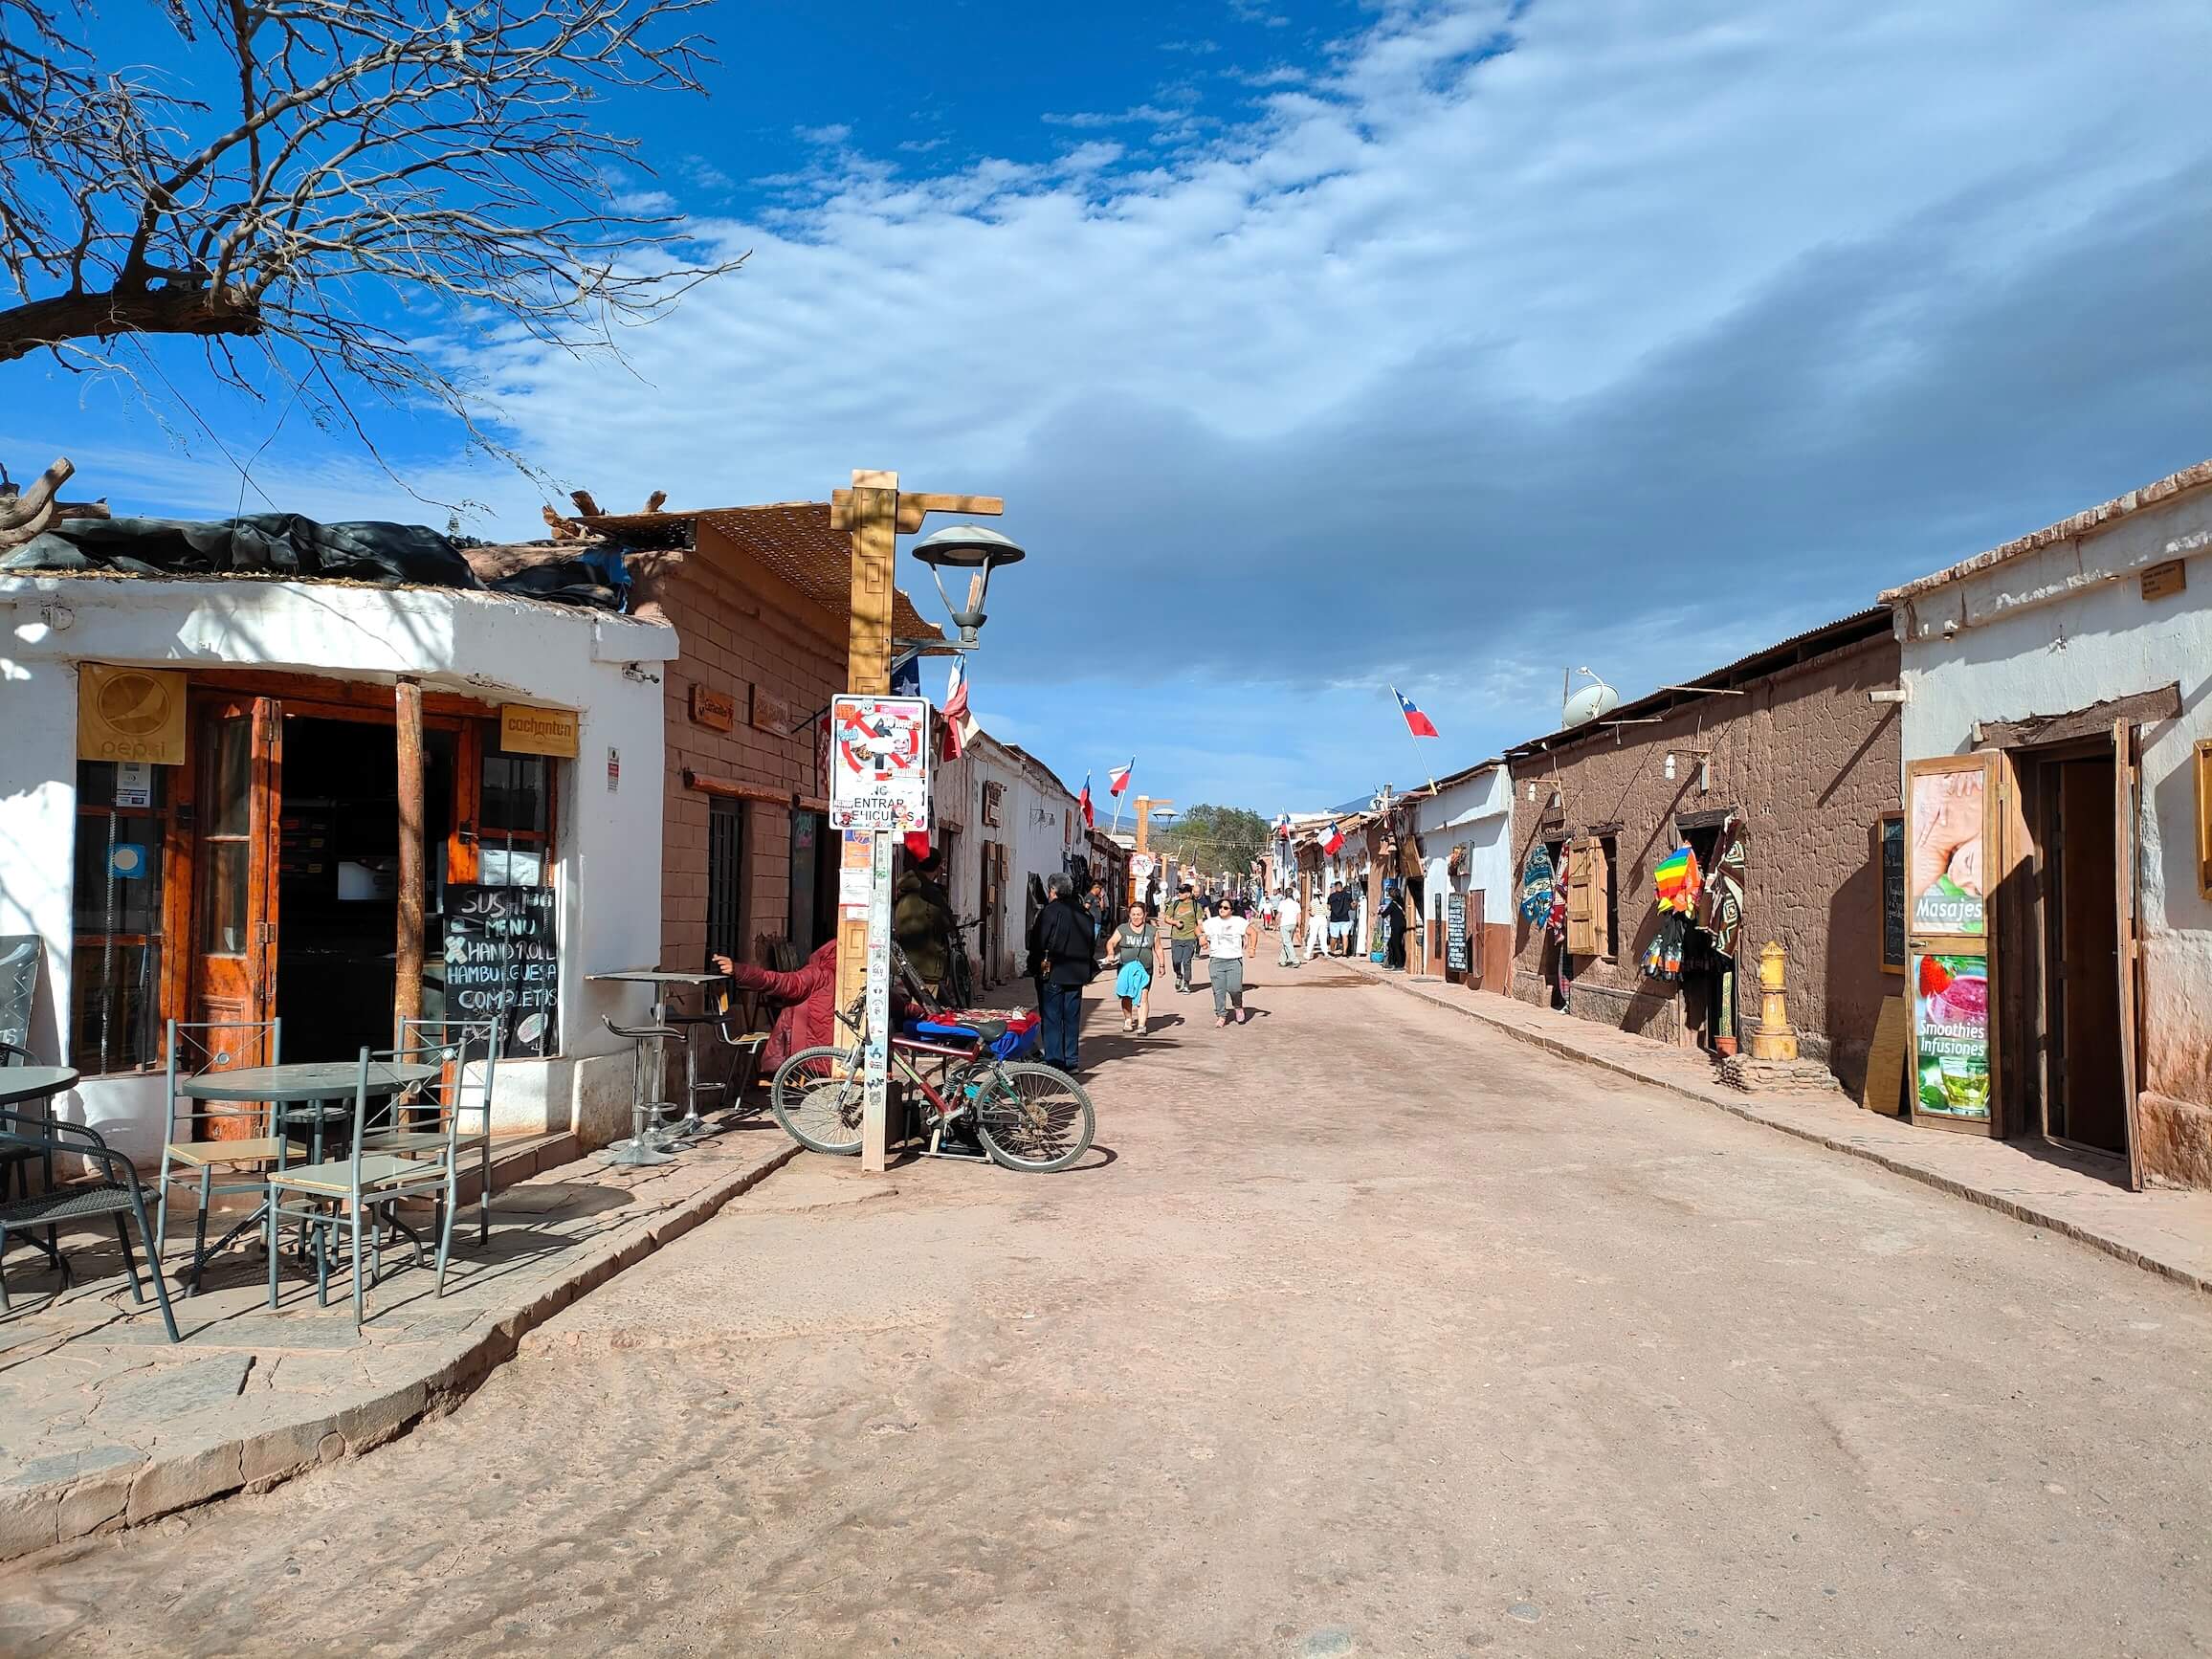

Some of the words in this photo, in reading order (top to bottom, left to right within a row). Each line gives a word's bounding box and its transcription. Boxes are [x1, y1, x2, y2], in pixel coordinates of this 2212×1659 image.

[1916, 898, 1983, 921] Masajes
[485, 918, 536, 938] MENU
[1920, 1020, 1985, 1039] Smoothies
[1921, 1037, 1985, 1057] Infusiones
